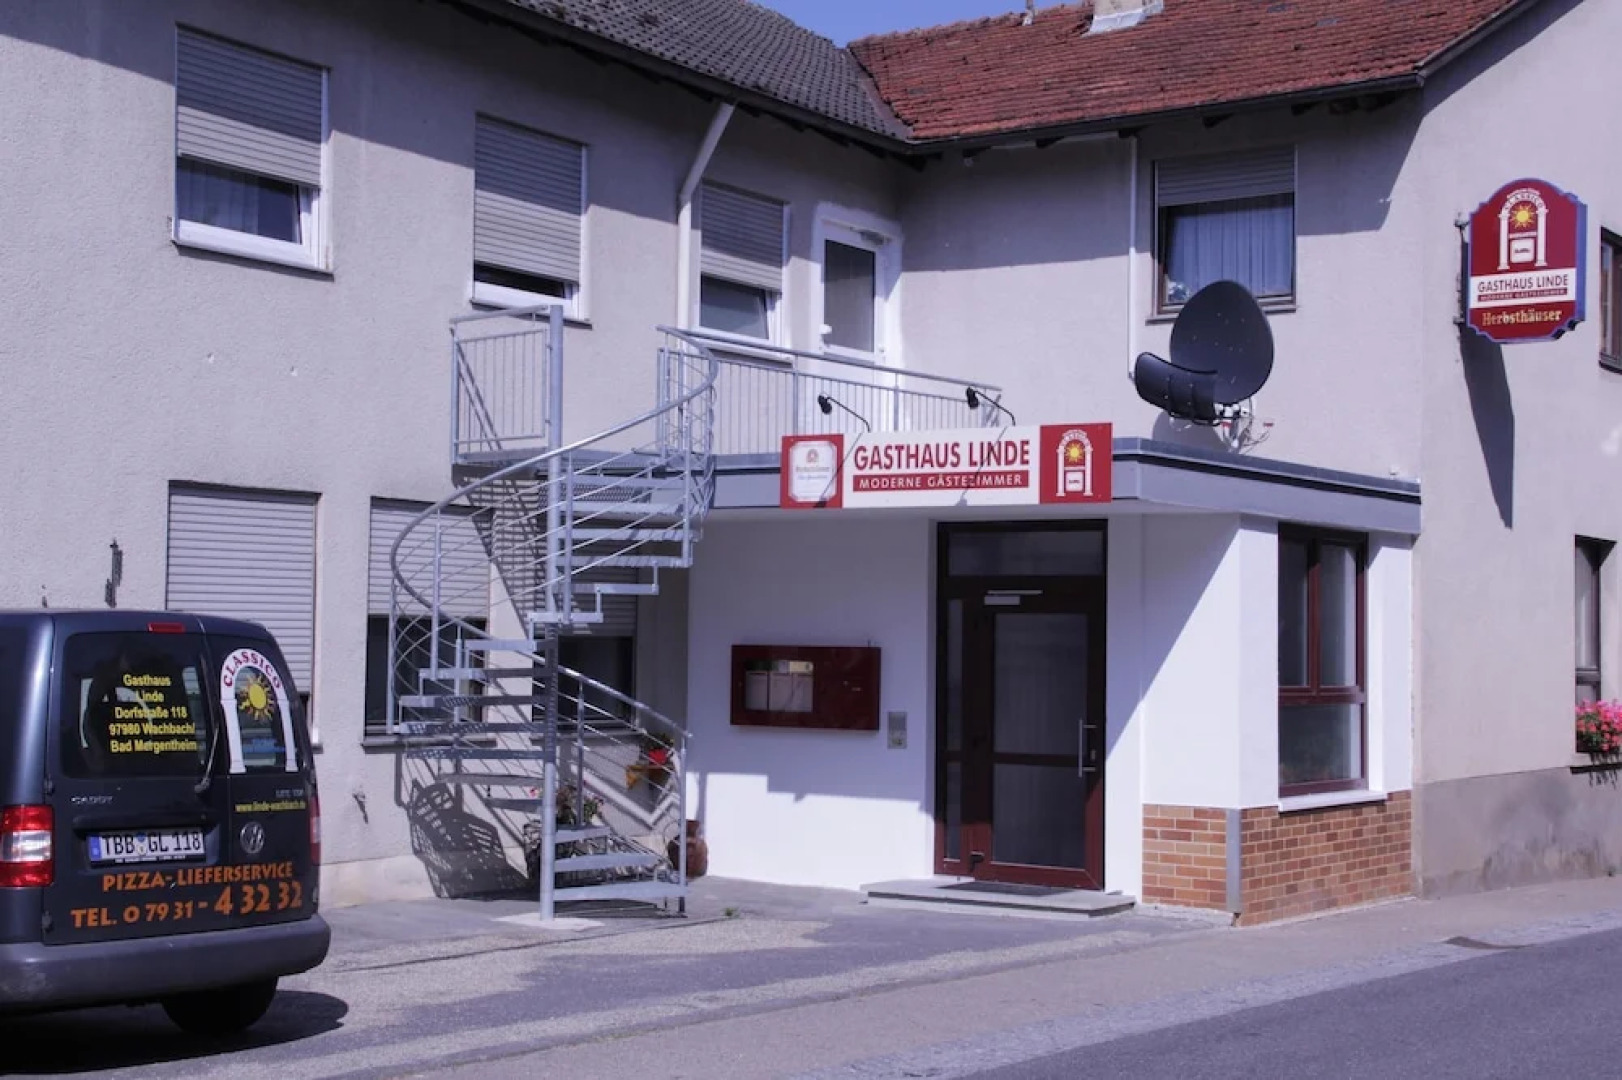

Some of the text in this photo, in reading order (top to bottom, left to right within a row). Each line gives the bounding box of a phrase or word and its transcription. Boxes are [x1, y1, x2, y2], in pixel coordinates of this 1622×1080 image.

[1478, 273, 1569, 293] GASTHAUS LINDE
[1482, 308, 1563, 327] Herbsthäuser
[854, 440, 1030, 471] GASTHAUS LINDE
[859, 473, 1022, 489] MODERNE GÄSTEZIMMER
[223, 651, 283, 689] CLASSICO
[123, 674, 171, 686] Gasthaus
[171, 706, 188, 719] 118
[109, 722, 141, 735] 97980
[110, 739, 197, 755] Bad Mergentheim
[101, 831, 203, 856] TBB GL 118
[70, 907, 117, 928] TEL.
